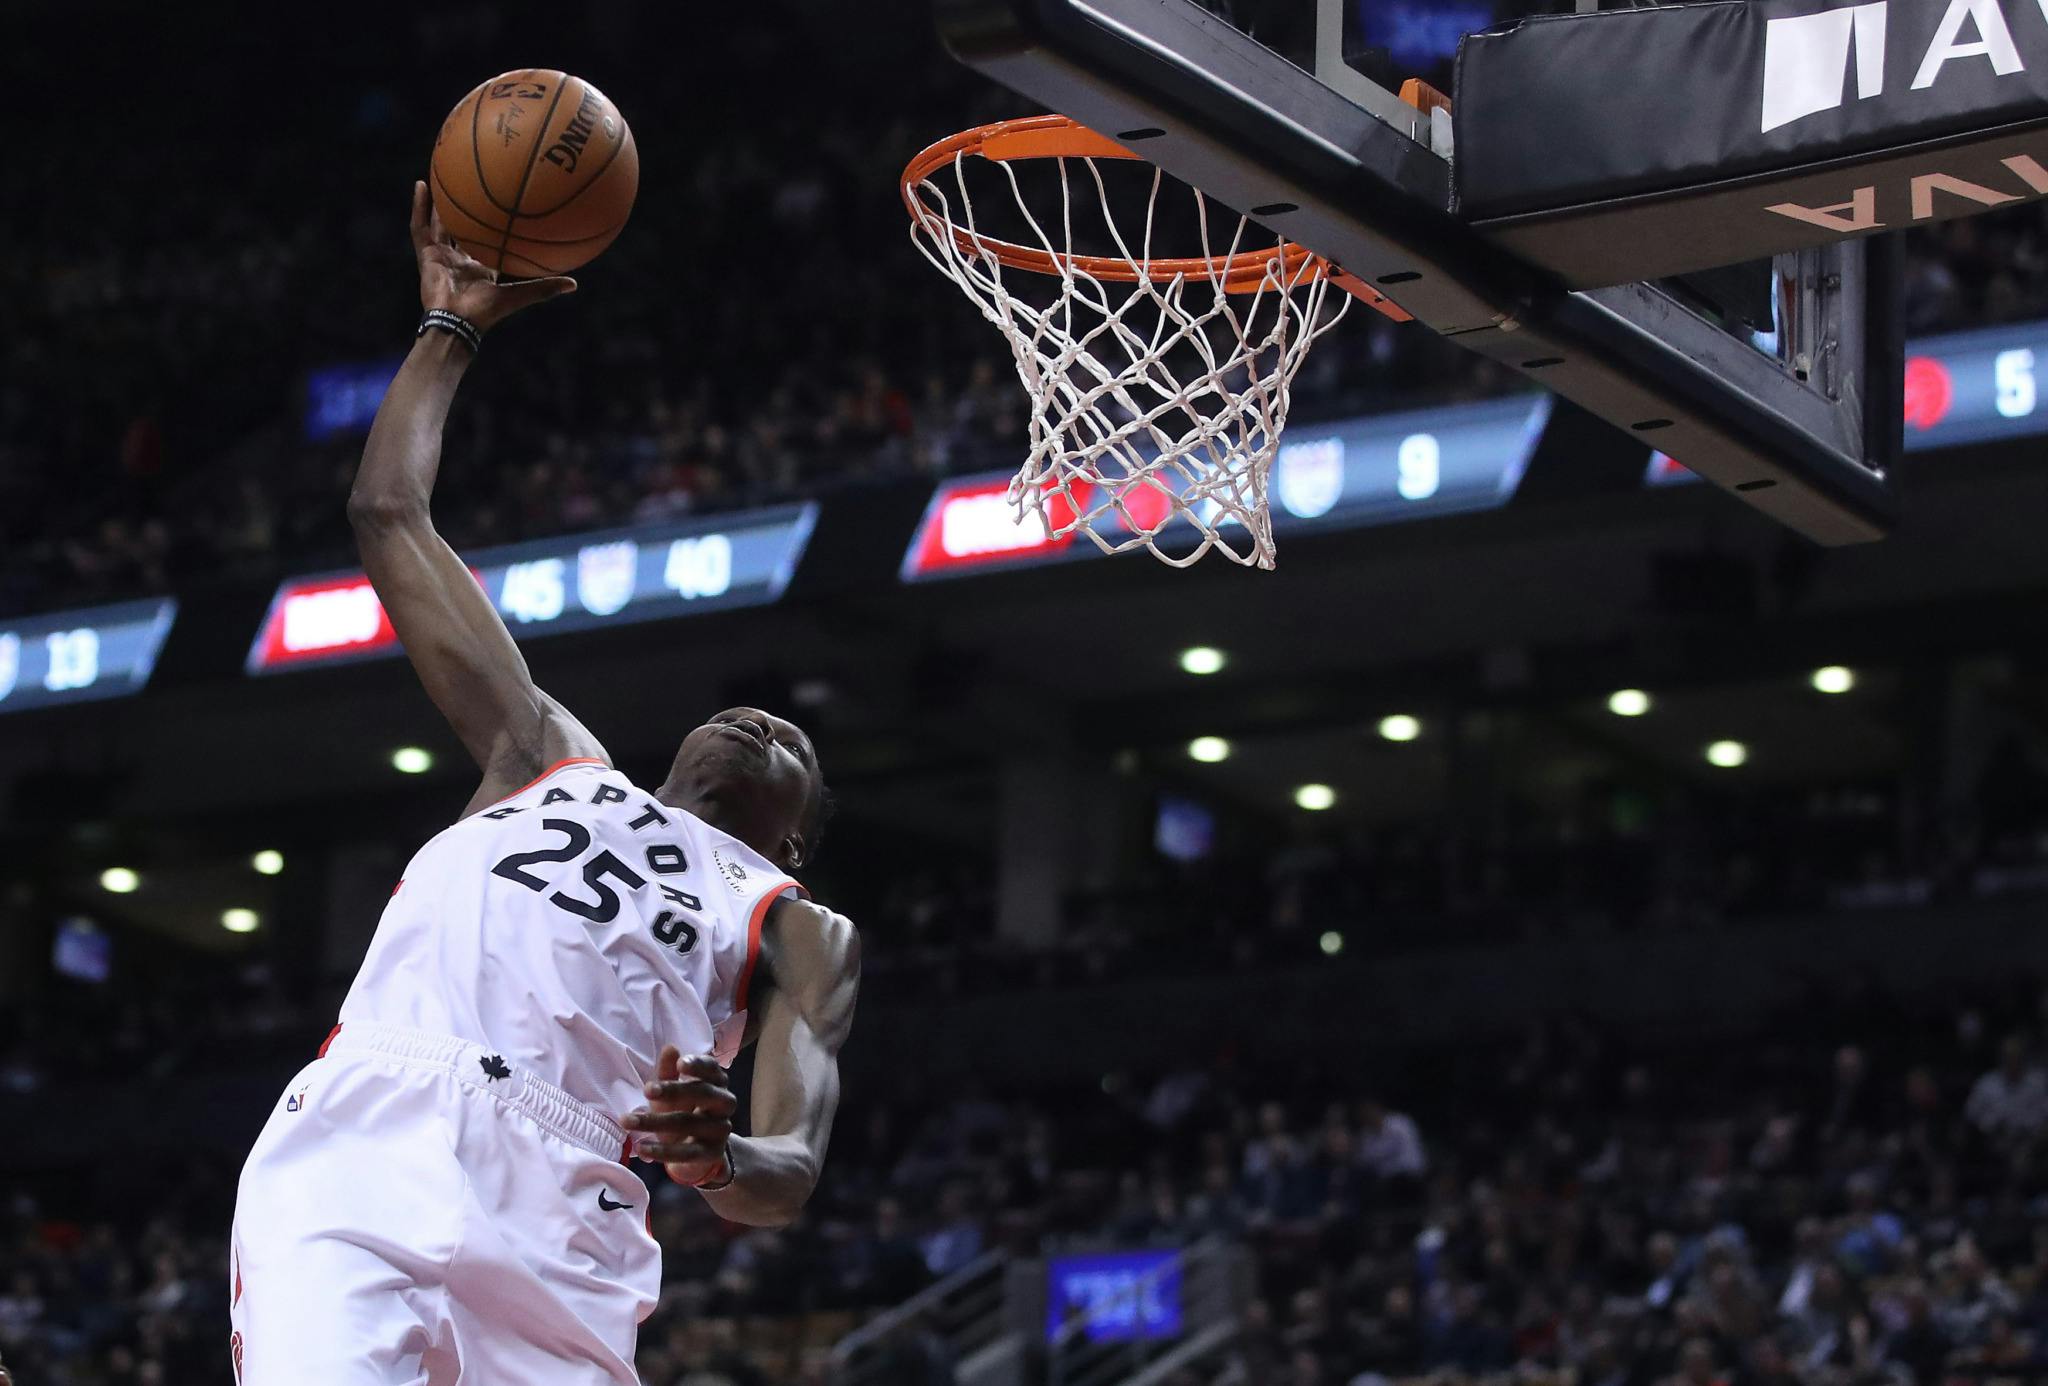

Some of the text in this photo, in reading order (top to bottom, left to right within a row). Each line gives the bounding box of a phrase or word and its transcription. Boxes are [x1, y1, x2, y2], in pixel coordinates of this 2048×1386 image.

[1995, 349, 2036, 417] 5
[1398, 432, 1439, 500] 9
[664, 536, 732, 598] 40
[482, 783, 703, 956] RAPTORS
[490, 818, 648, 924] 25
